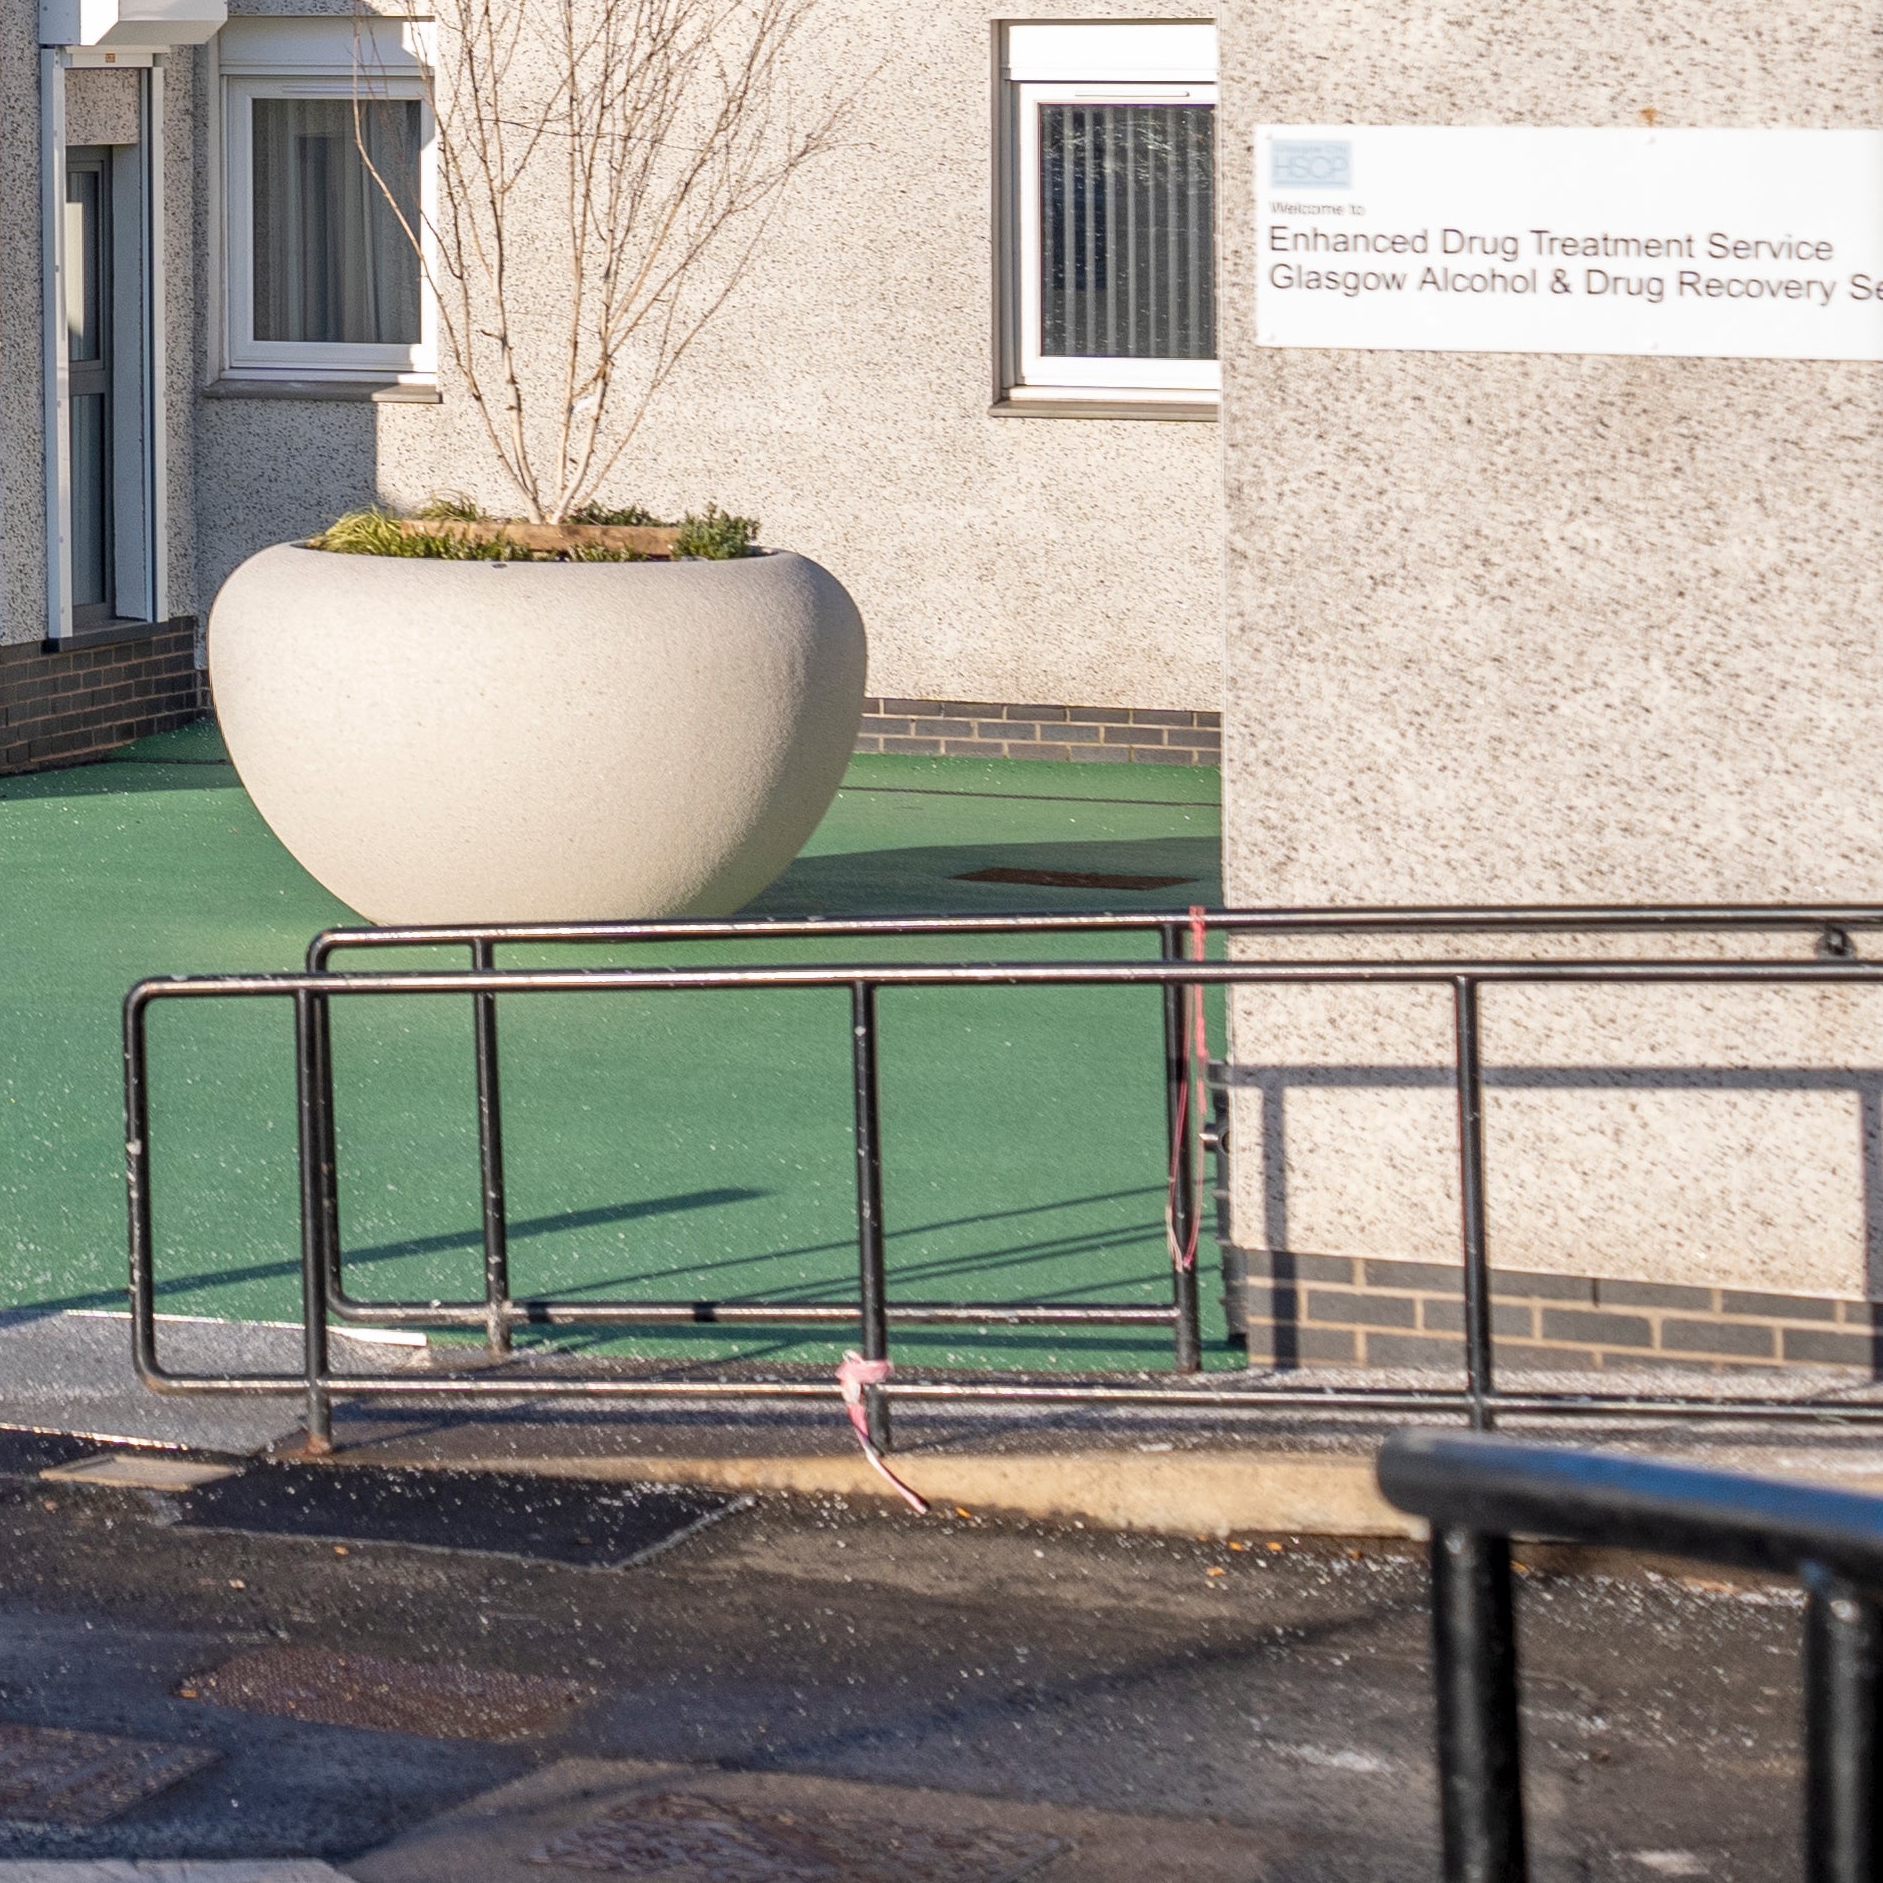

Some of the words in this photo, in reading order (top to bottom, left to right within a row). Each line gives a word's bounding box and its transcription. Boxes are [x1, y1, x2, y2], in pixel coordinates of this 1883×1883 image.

[1273, 155, 1349, 179] HSCP
[1269, 200, 1345, 216] Welcome
[1348, 202, 1367, 216] to
[1269, 225, 1429, 254] Enhanced
[1442, 228, 1520, 262] Drug
[1529, 229, 1696, 259] Treatment
[1707, 232, 1835, 262] Service
[1269, 263, 1407, 297] Glasgow
[1417, 267, 1538, 294] Alcohol
[1548, 269, 1572, 295] &
[1586, 268, 1665, 304] Drug
[1678, 270, 1837, 307] Recovery
